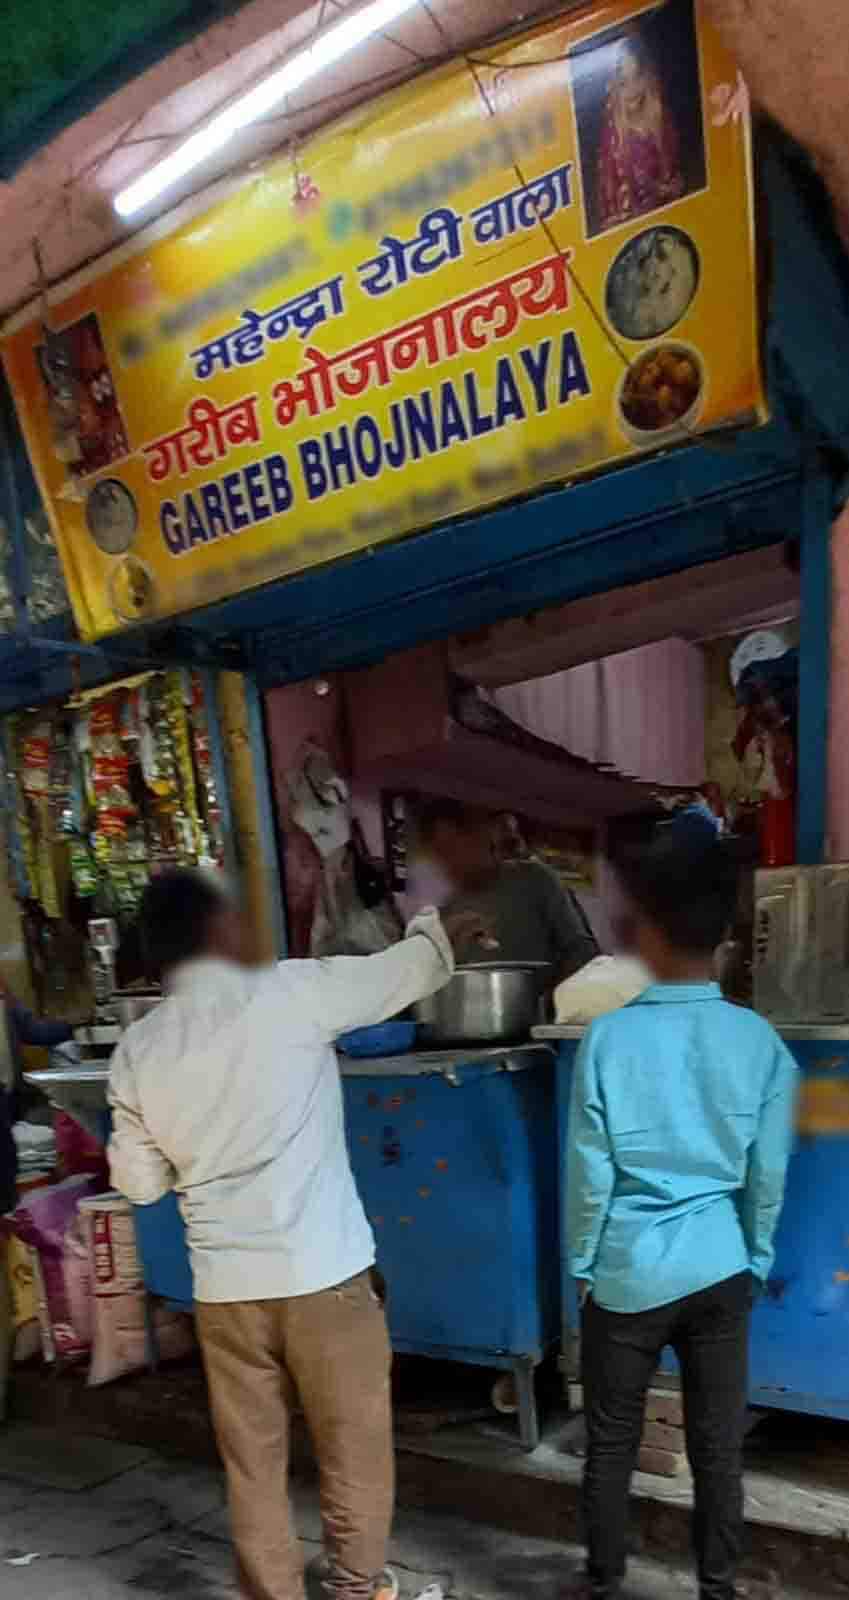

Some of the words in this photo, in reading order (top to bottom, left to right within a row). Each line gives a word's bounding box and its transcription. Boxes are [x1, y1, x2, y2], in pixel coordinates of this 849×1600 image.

[143, 396, 260, 480] गरीब
[273, 252, 572, 426] भोजनालय
[189, 276, 343, 378] महेन्द्रा
[357, 207, 463, 295] रोटी
[471, 164, 572, 242] वाला
[160, 454, 294, 554] GAREEB
[298, 331, 591, 500] BHOJNALAYA
